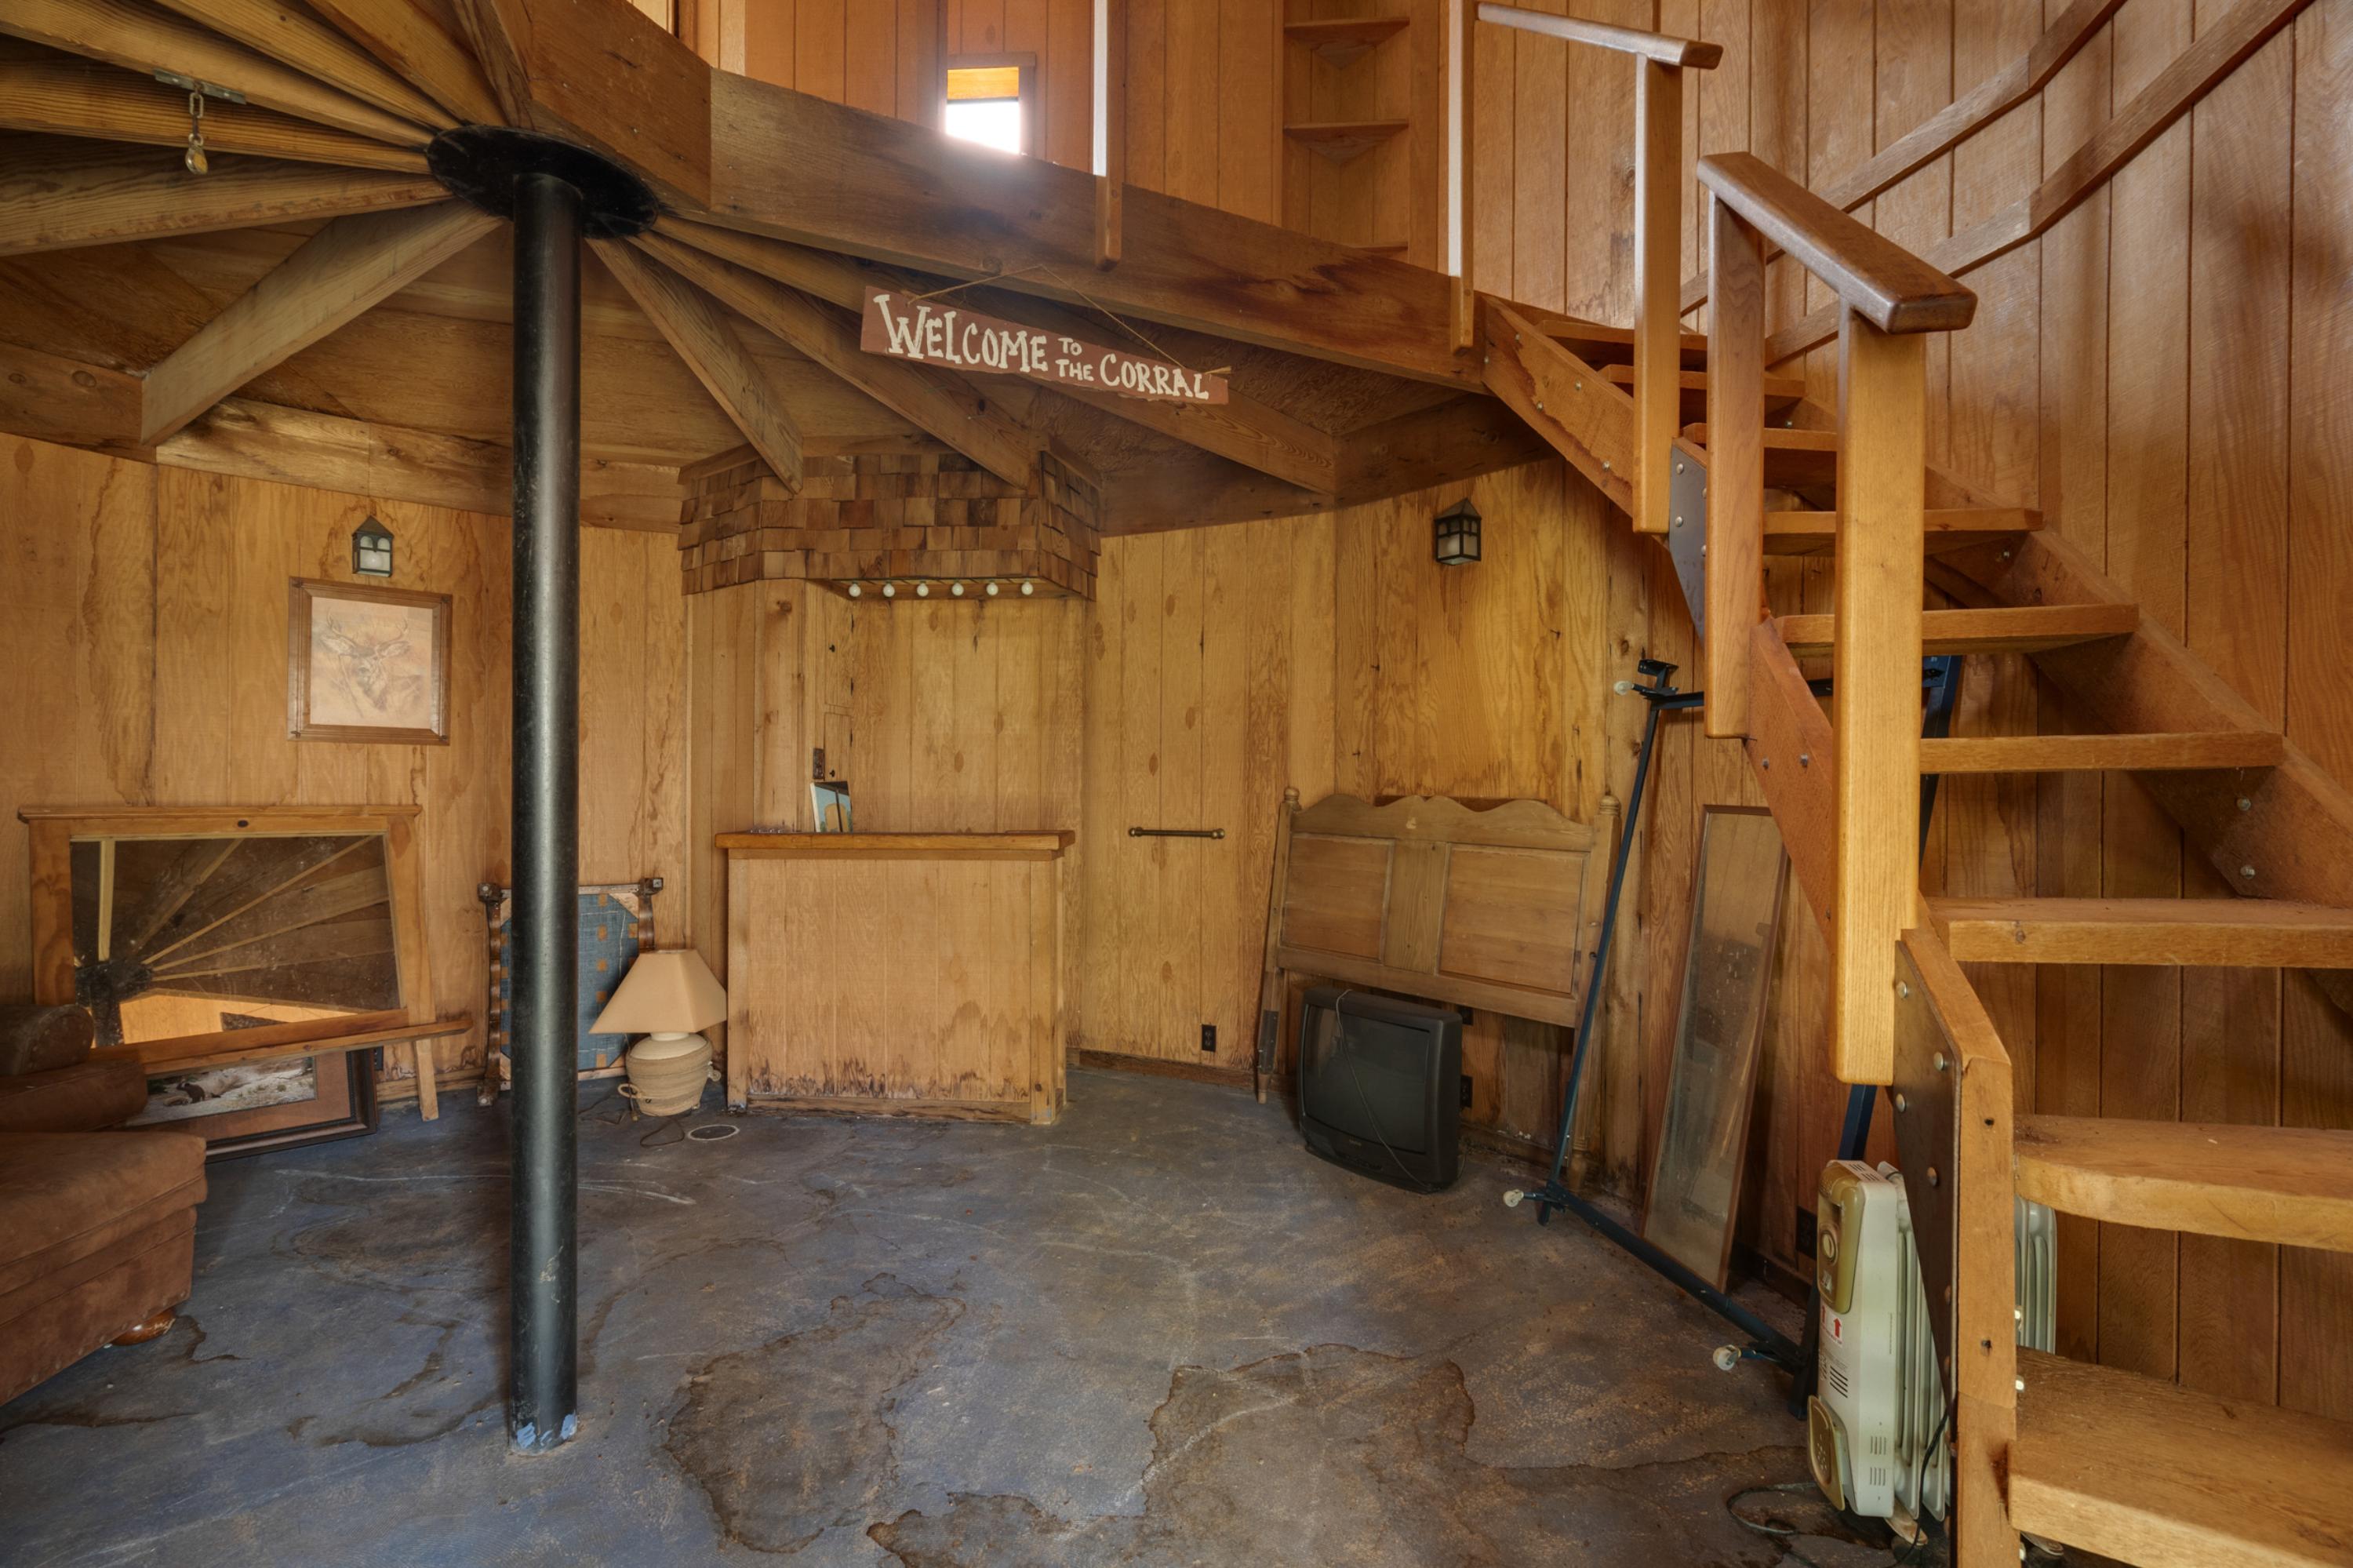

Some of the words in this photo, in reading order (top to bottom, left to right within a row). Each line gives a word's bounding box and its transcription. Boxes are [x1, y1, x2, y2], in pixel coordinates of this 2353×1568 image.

[873, 294, 1048, 373] WELCOME
[1058, 337, 1082, 355] TO
[1055, 358, 1094, 381] THE
[1100, 353, 1209, 400] CORRAL
